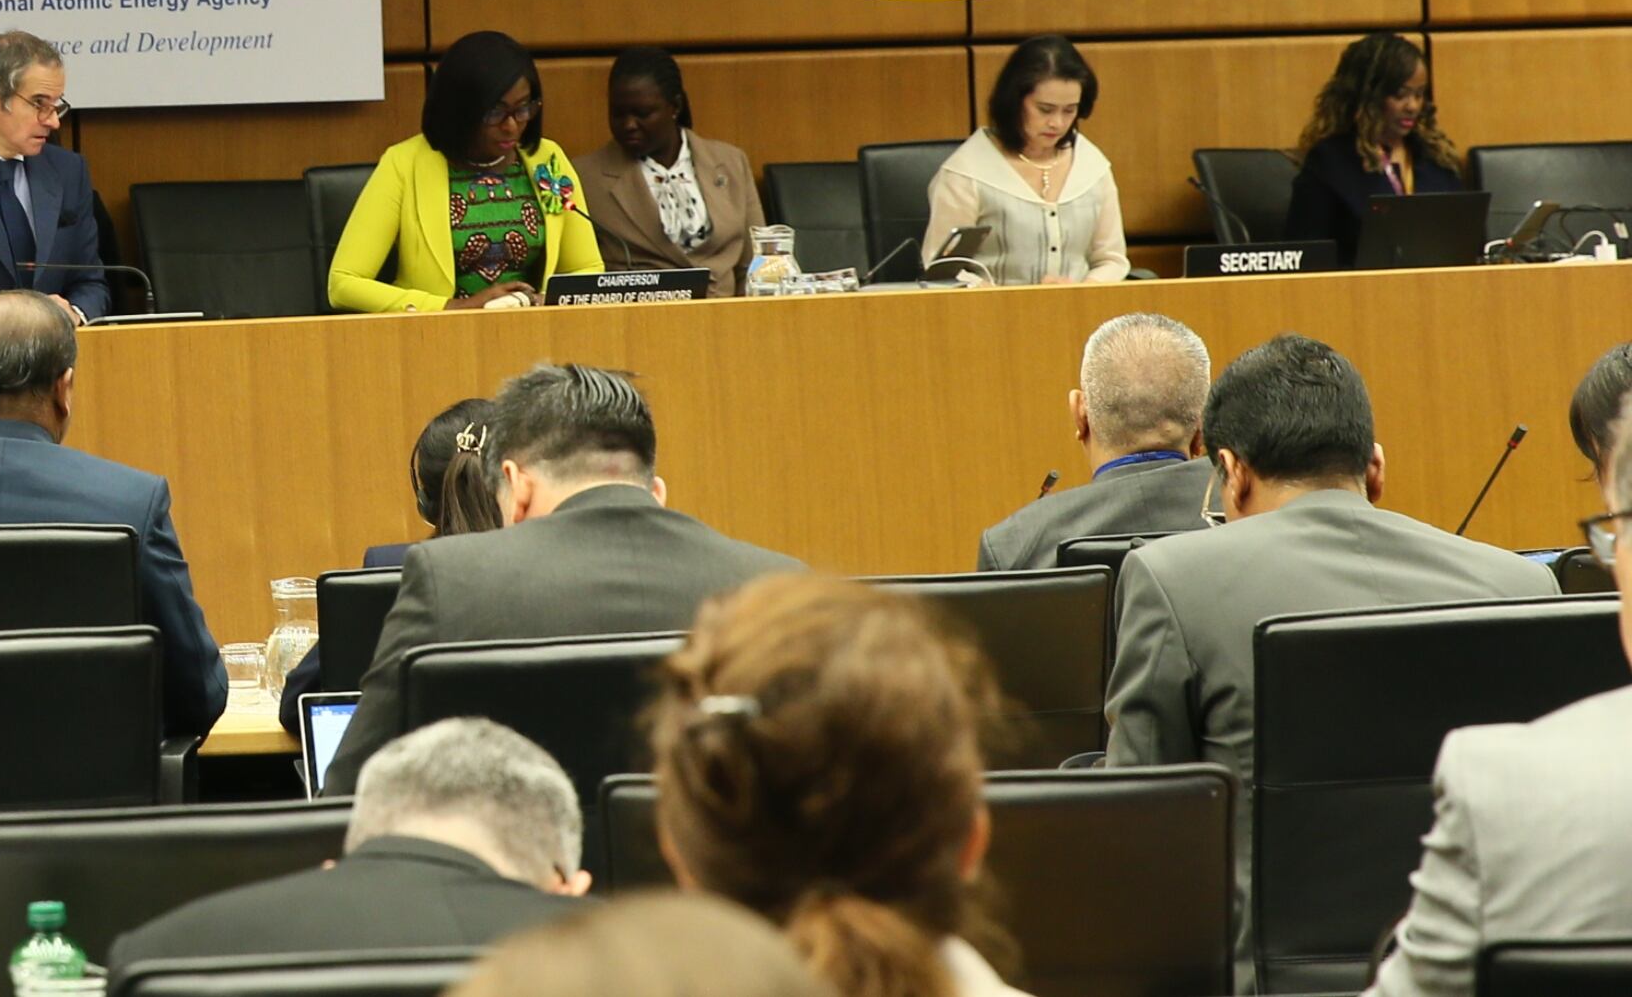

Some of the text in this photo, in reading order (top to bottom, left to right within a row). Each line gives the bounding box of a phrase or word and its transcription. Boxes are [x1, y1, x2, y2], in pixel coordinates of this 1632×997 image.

[89, 31, 132, 55] and
[136, 30, 275, 58] Development
[1220, 250, 1303, 272] SECRETARY
[597, 273, 660, 288] CHAIRPERSON
[558, 289, 692, 306] OF THE BOARD OF GOVERNORS
